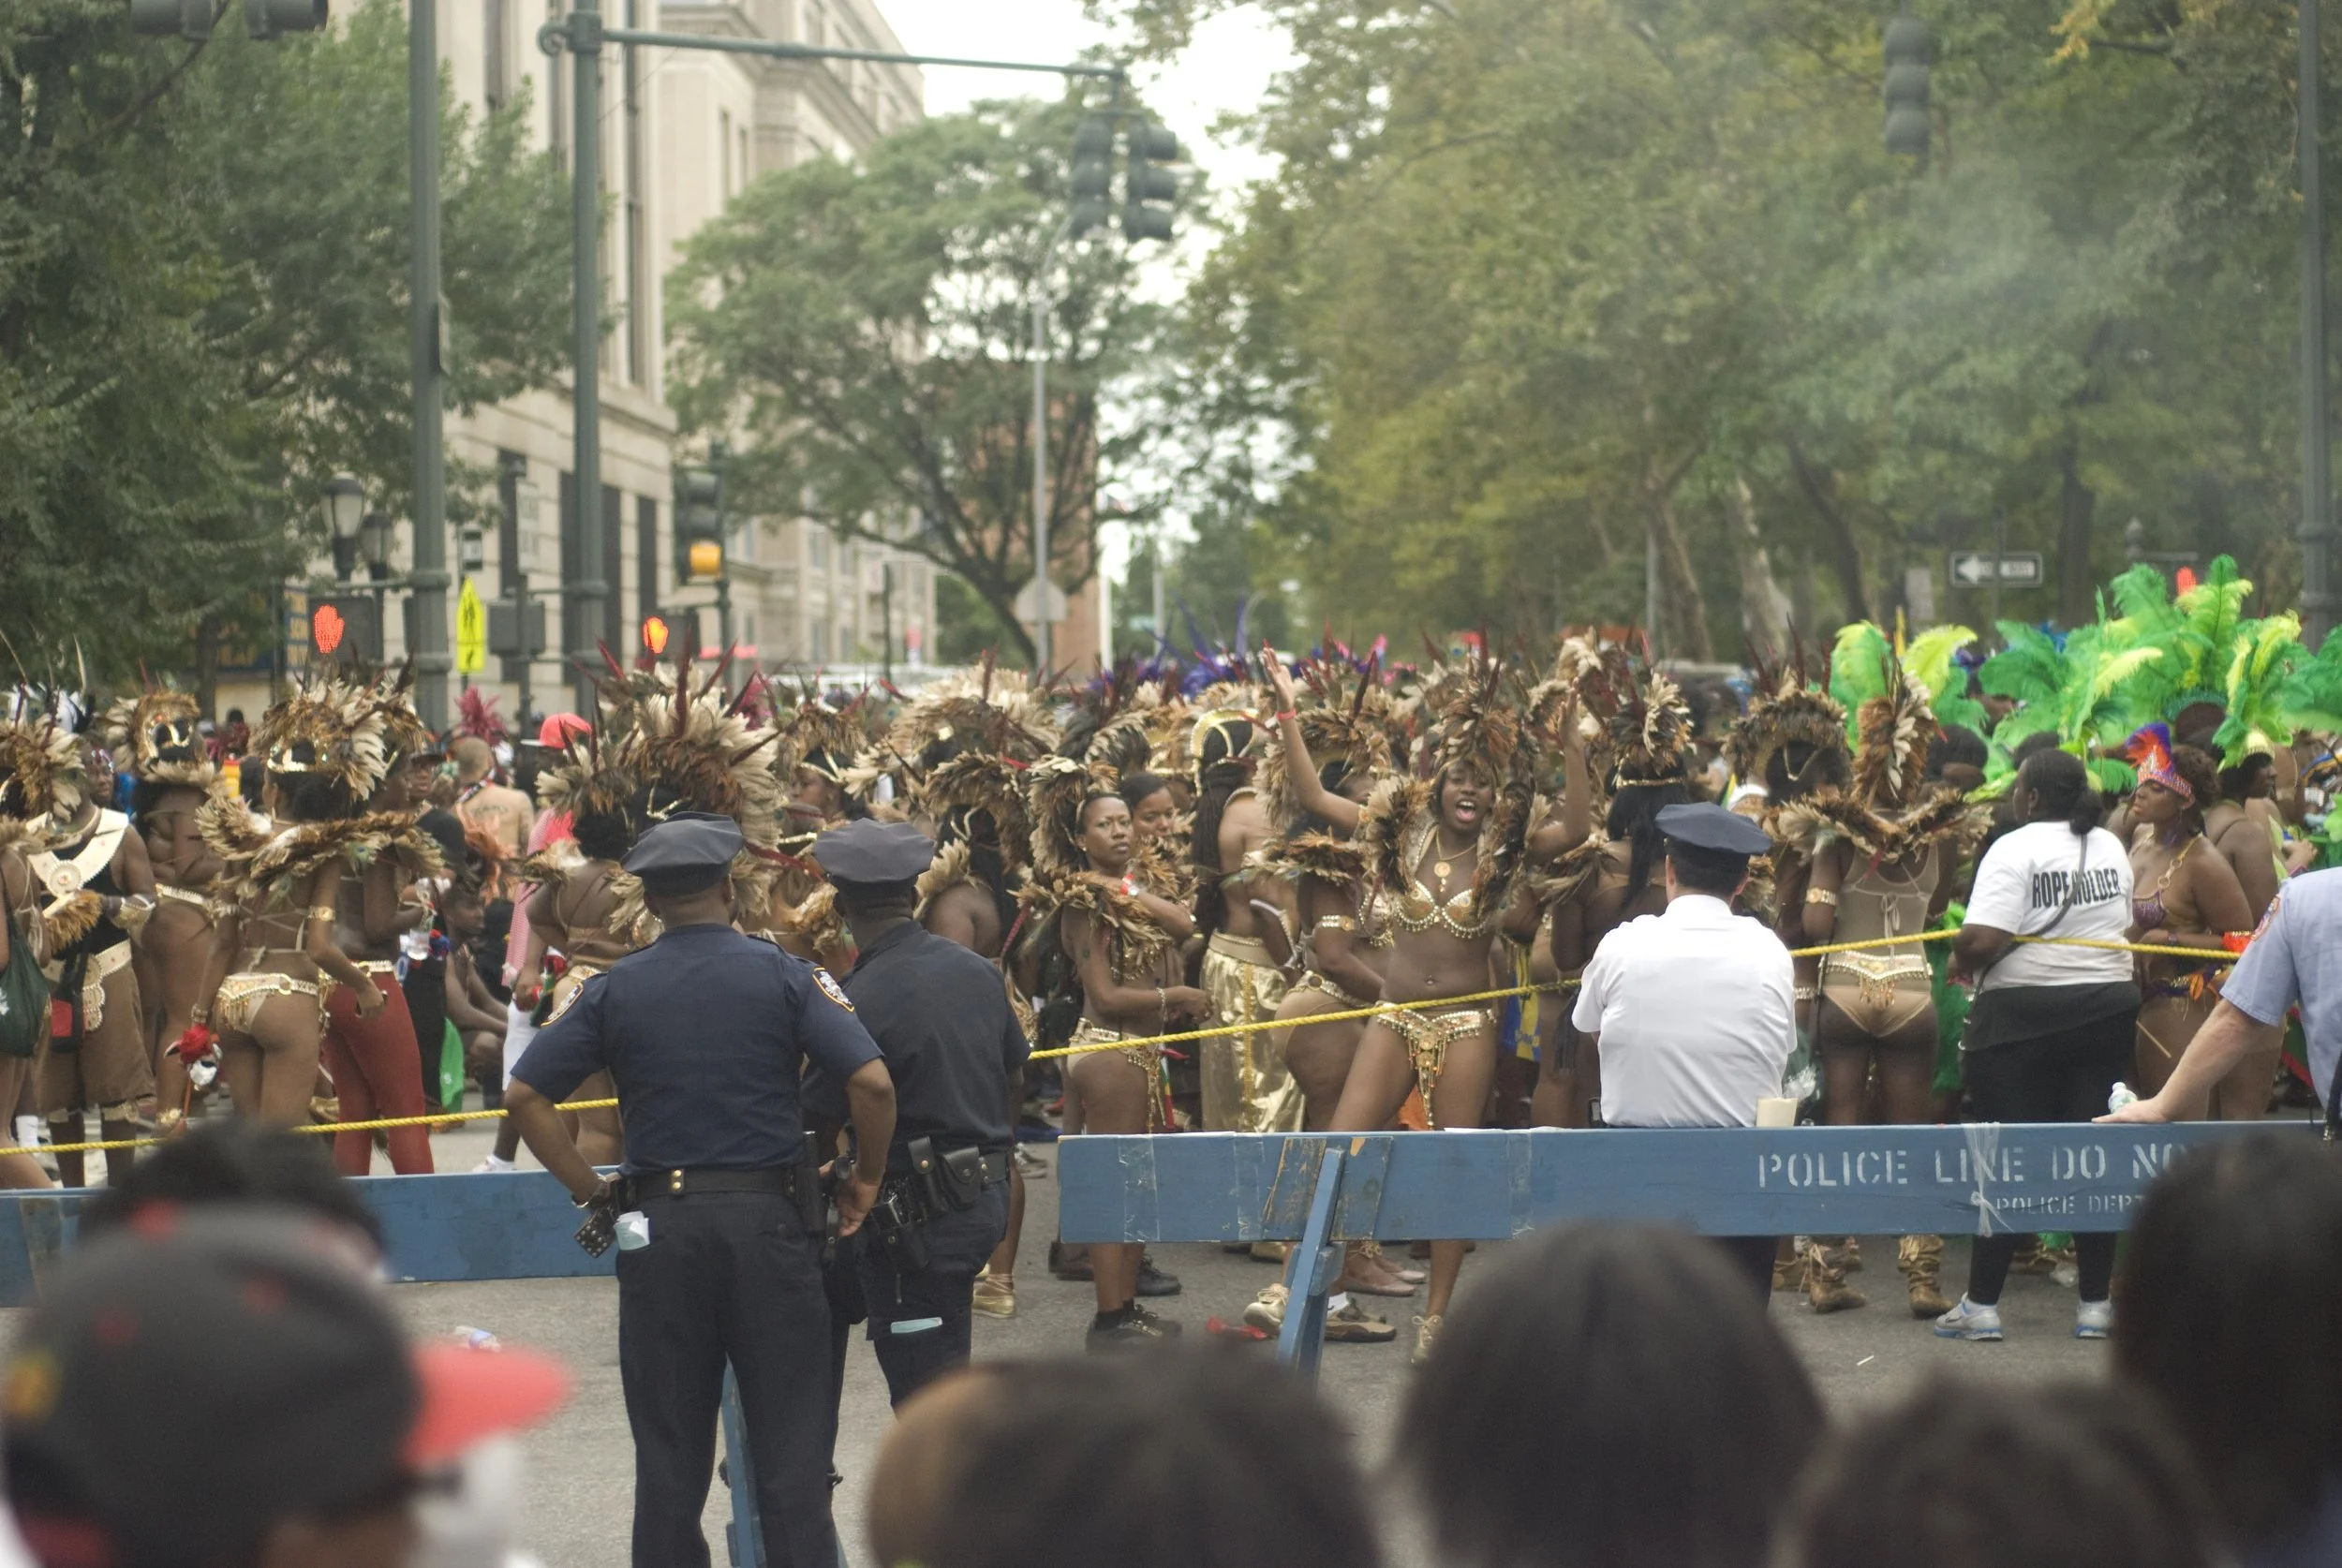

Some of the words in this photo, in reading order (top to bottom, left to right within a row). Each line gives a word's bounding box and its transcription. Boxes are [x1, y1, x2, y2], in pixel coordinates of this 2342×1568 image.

[2032, 871, 2069, 909] ROPE
[2071, 868, 2121, 906] HOLDER
[1759, 1150, 1907, 1188] POLICE
[1935, 1146, 2023, 1182] LINE
[2053, 1145, 2106, 1180] DO
[2132, 1143, 2189, 1178] NO
[1997, 1196, 2075, 1215] POLICE
